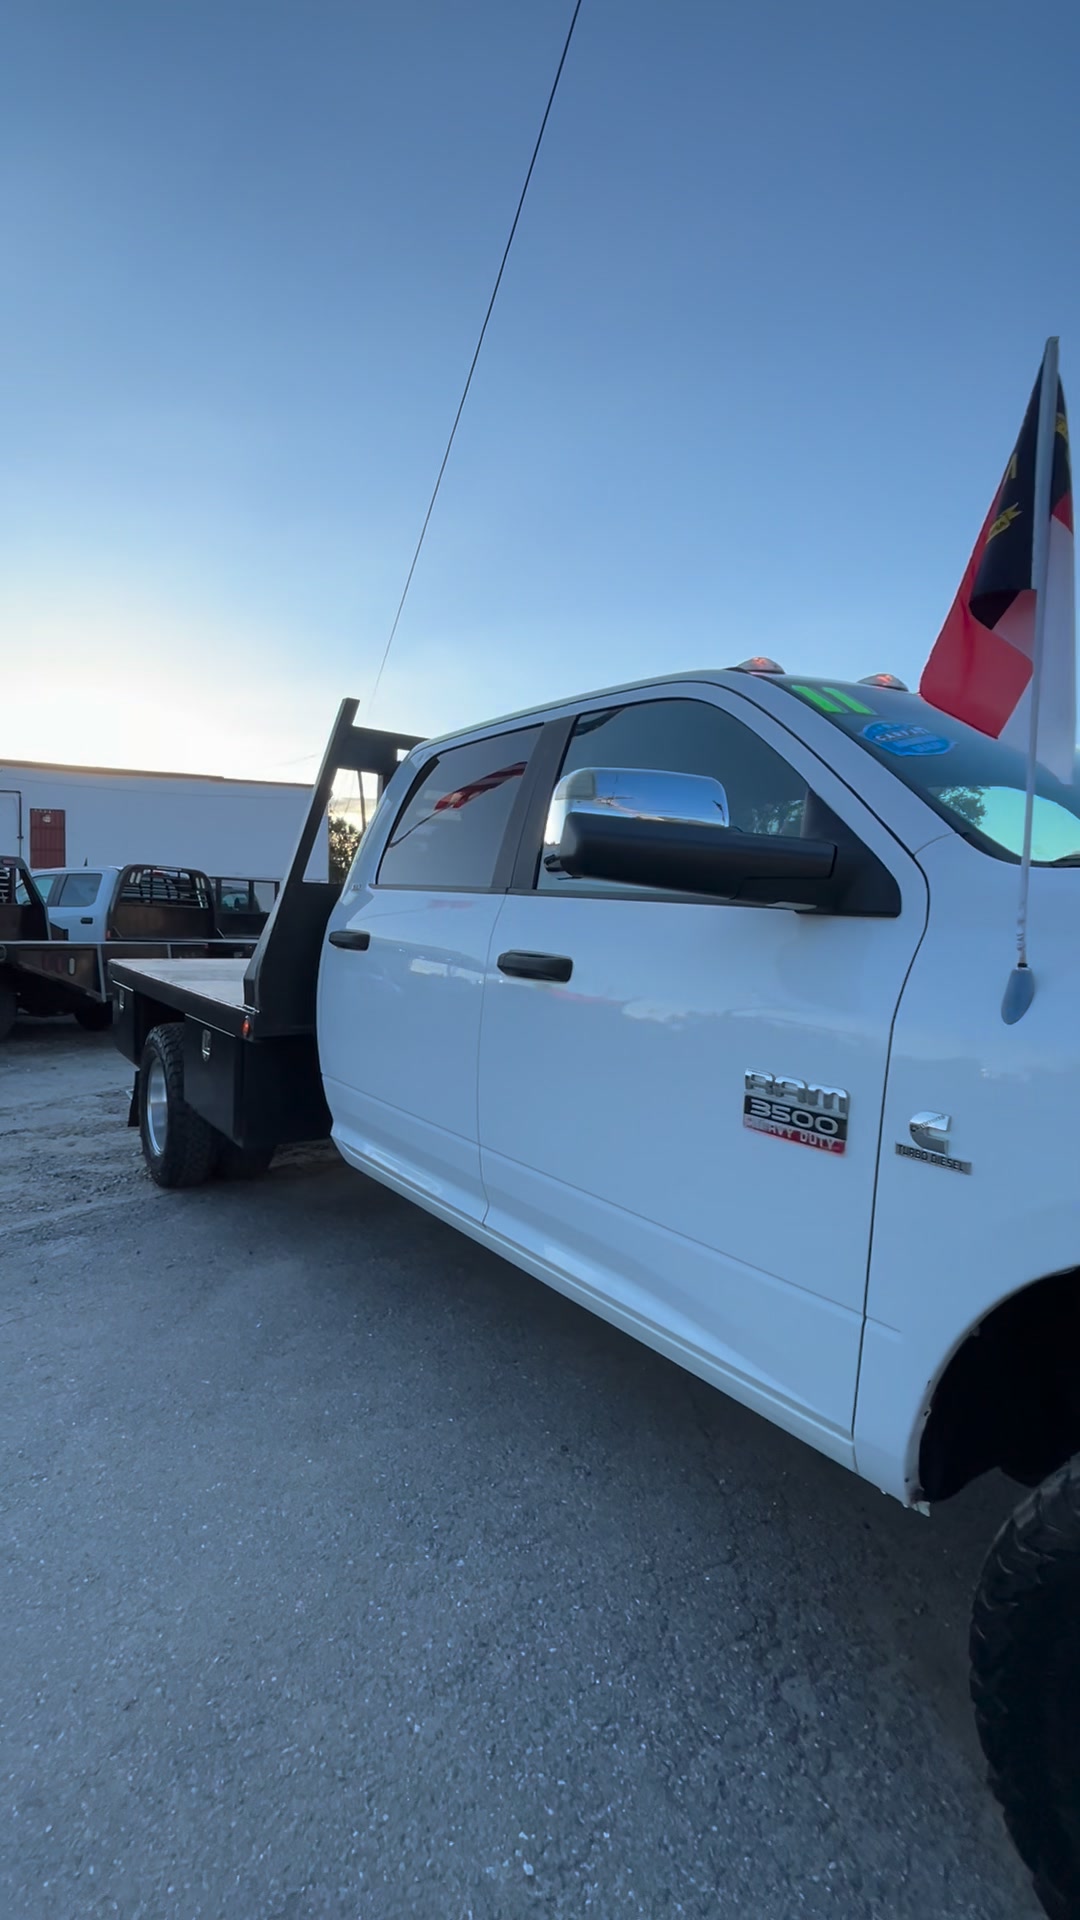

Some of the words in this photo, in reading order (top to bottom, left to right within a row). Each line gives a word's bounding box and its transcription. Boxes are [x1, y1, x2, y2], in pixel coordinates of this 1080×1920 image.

[791, 685, 877, 716] 11
[750, 1098, 839, 1135] 3500
[800, 1132, 834, 1150] DUTY
[897, 1144, 928, 1161] TURBO
[930, 1154, 964, 1172] DIESEL
